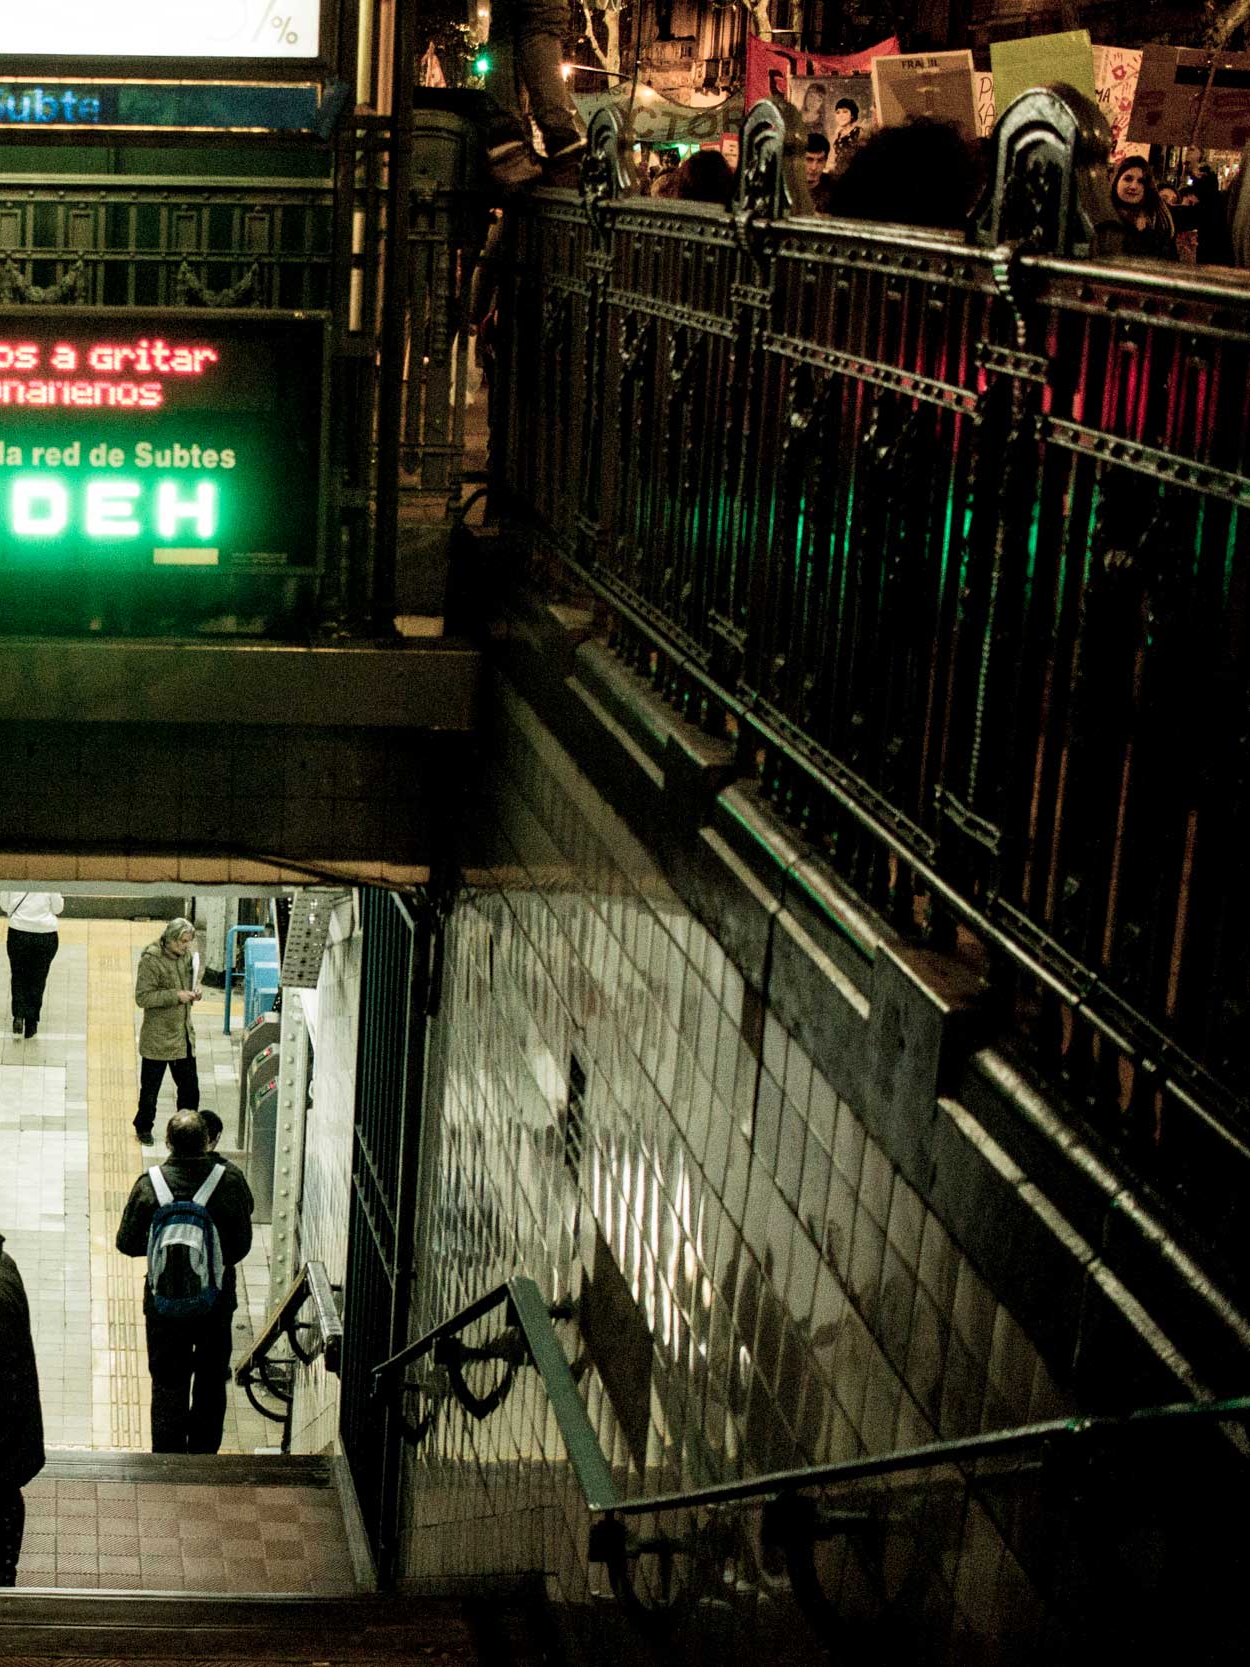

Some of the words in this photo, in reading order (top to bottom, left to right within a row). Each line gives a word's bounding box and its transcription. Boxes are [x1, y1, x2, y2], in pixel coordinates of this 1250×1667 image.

[51, 344, 77, 371] a
[33, 442, 81, 467] red
[90, 443, 125, 468] de
[135, 443, 237, 469] Subtes
[11, 477, 69, 537] D
[85, 480, 141, 537] E
[157, 480, 216, 538] H
